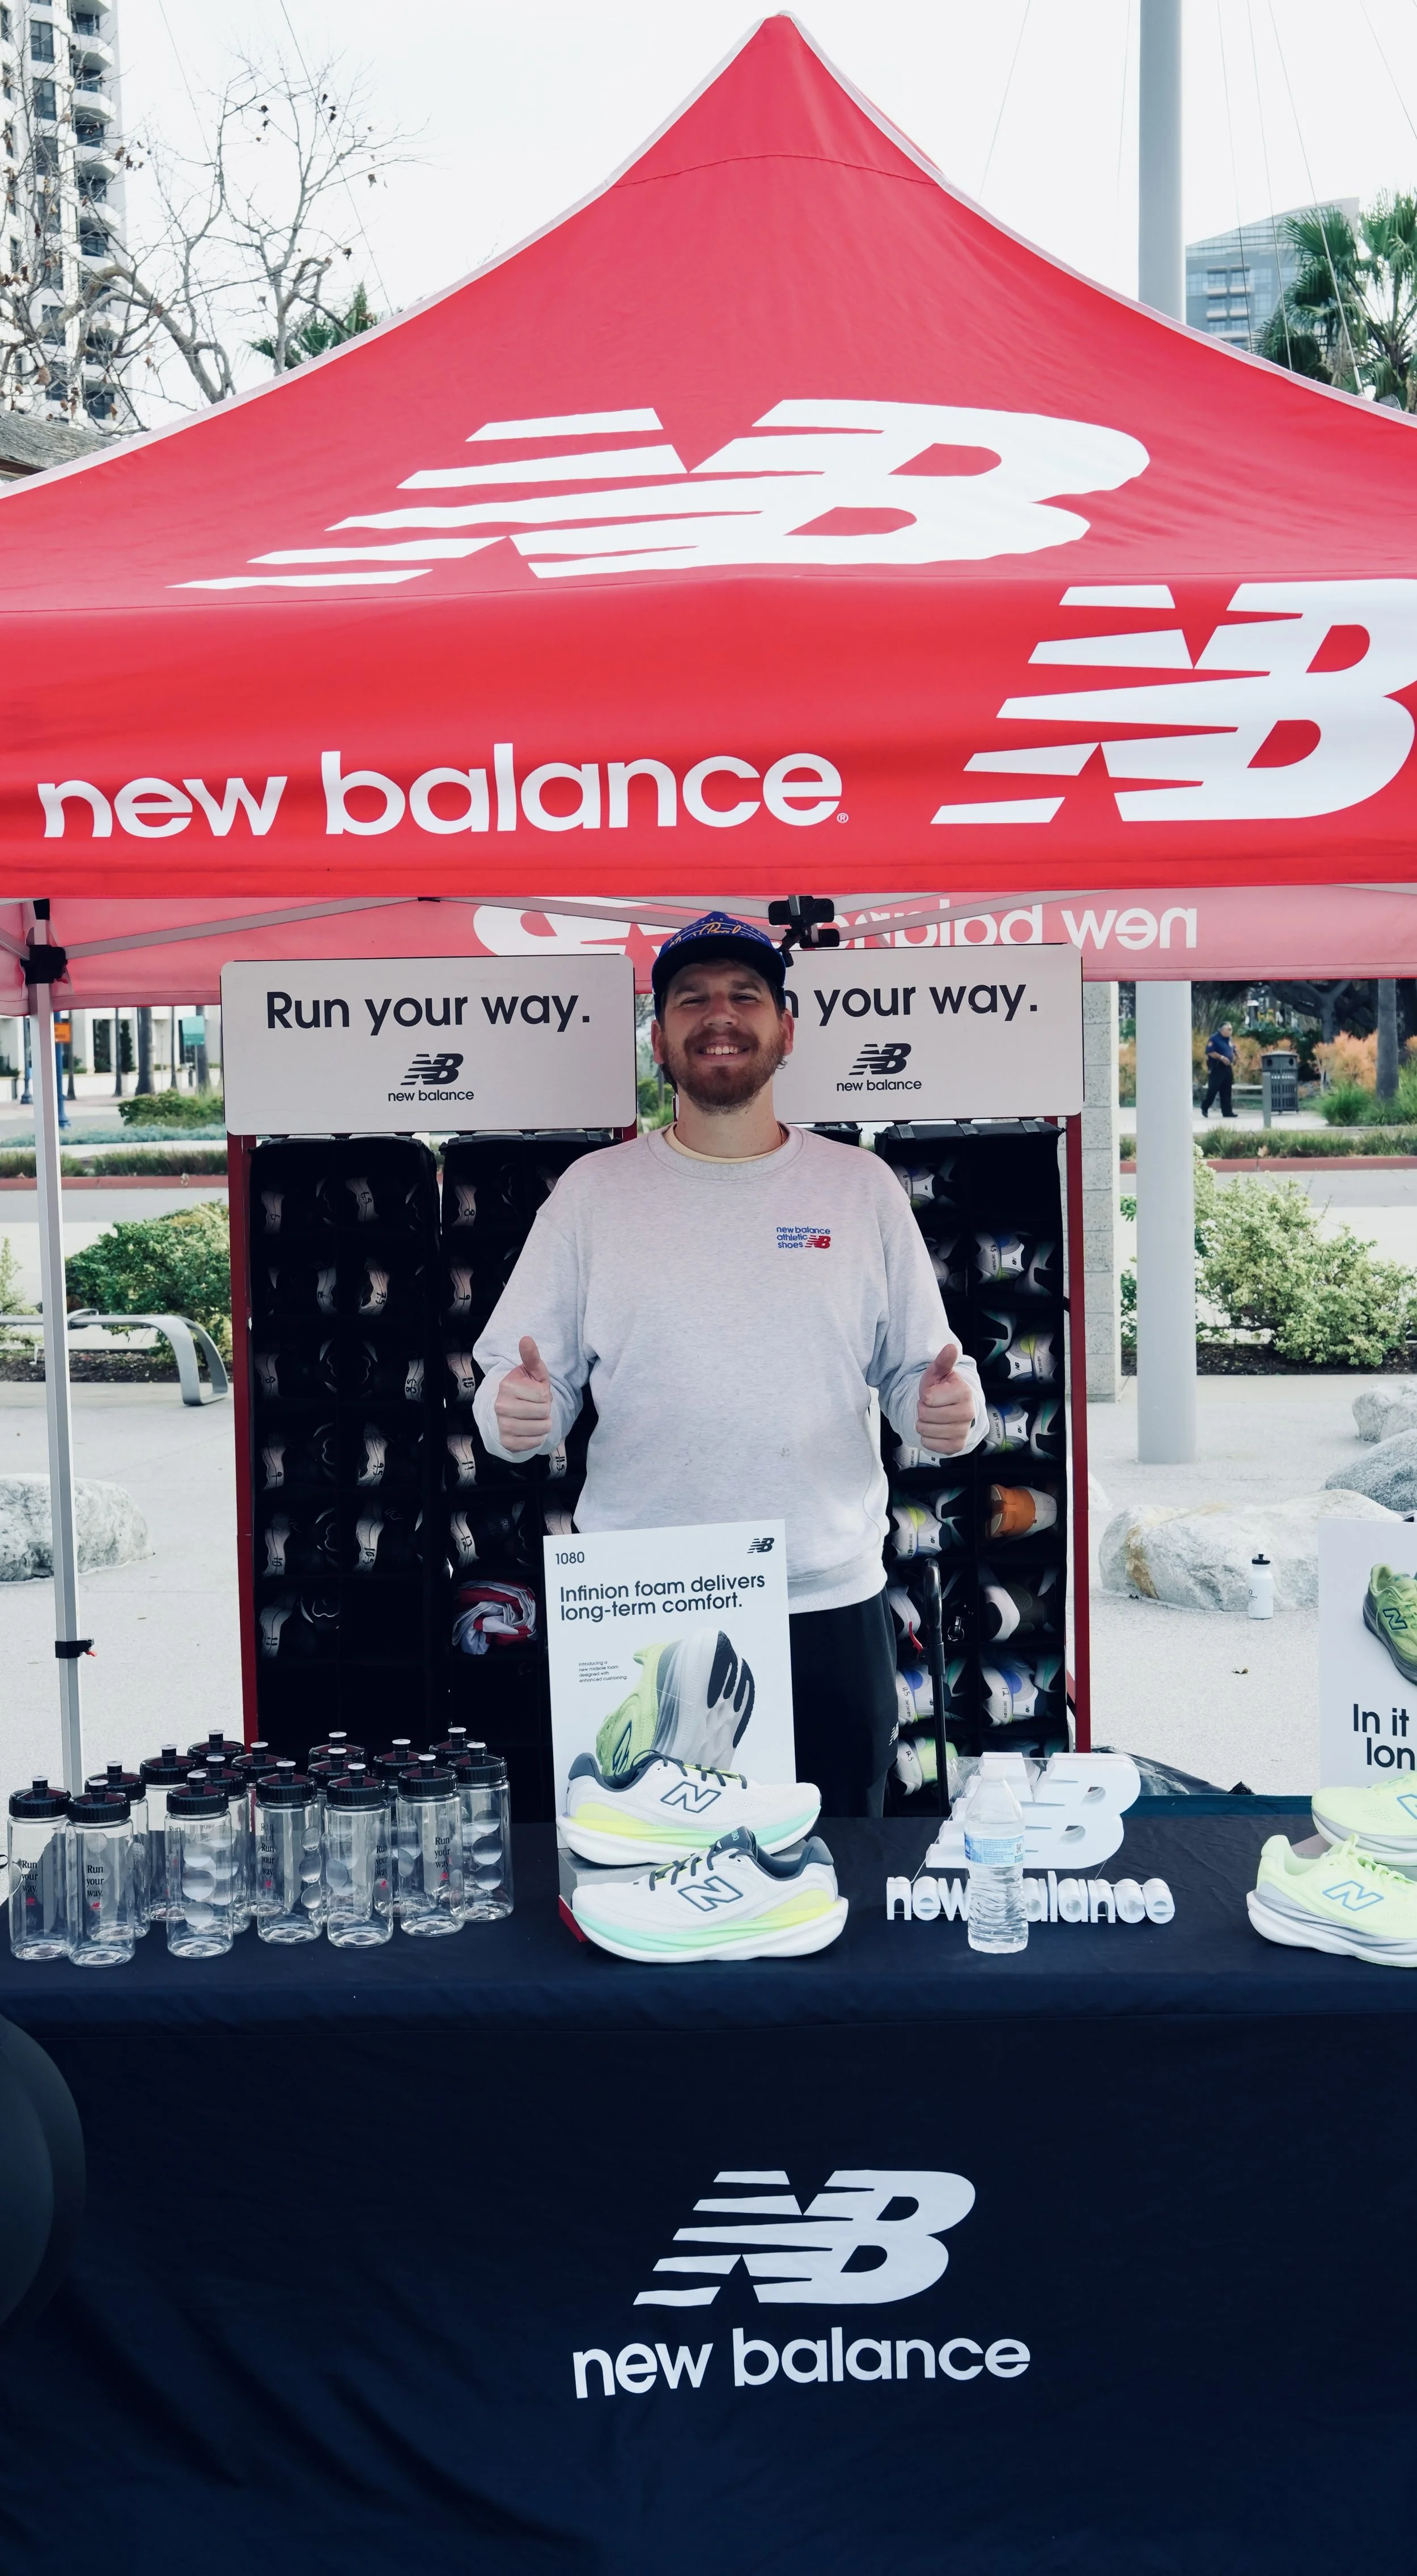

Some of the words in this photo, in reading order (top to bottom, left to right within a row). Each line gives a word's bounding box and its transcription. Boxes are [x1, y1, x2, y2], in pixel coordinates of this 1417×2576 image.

[37, 777, 287, 838] new
[814, 987, 915, 1026] your
[930, 984, 1037, 1021] way.
[268, 992, 350, 1028] Run
[364, 996, 468, 1036] your
[481, 994, 590, 1032] way.
[837, 1082, 863, 1091] new
[867, 1078, 922, 1091] balance
[388, 1092, 414, 1101] new
[419, 1089, 474, 1101] balance
[555, 1552, 584, 1565] 1080
[561, 1583, 629, 1602] Infinion
[635, 1581, 685, 1596] foam
[691, 1574, 765, 1592] delivers
[561, 1601, 656, 1622] long-term
[663, 1592, 742, 1613] comfort.
[1354, 1704, 1380, 1734] In
[1392, 1708, 1409, 1737] it
[1367, 1737, 1416, 1770] lon
[660, 1781, 721, 1813] N
[262, 1843, 274, 1852] Run
[376, 1845, 387, 1853] Run
[434, 1848, 451, 1859] your
[22, 1860, 37, 1869] Run
[262, 1855, 275, 1865] your
[376, 1856, 388, 1867] your
[22, 1873, 38, 1883] your
[86, 1878, 104, 1887] your
[23, 1886, 37, 1895] way.
[87, 1889, 103, 1899] way.
[678, 1875, 743, 1912] N
[886, 1876, 970, 1921] new
[1023, 1871, 1175, 1924] alance
[573, 2343, 712, 2399] new
[733, 2327, 1031, 2387] balance
